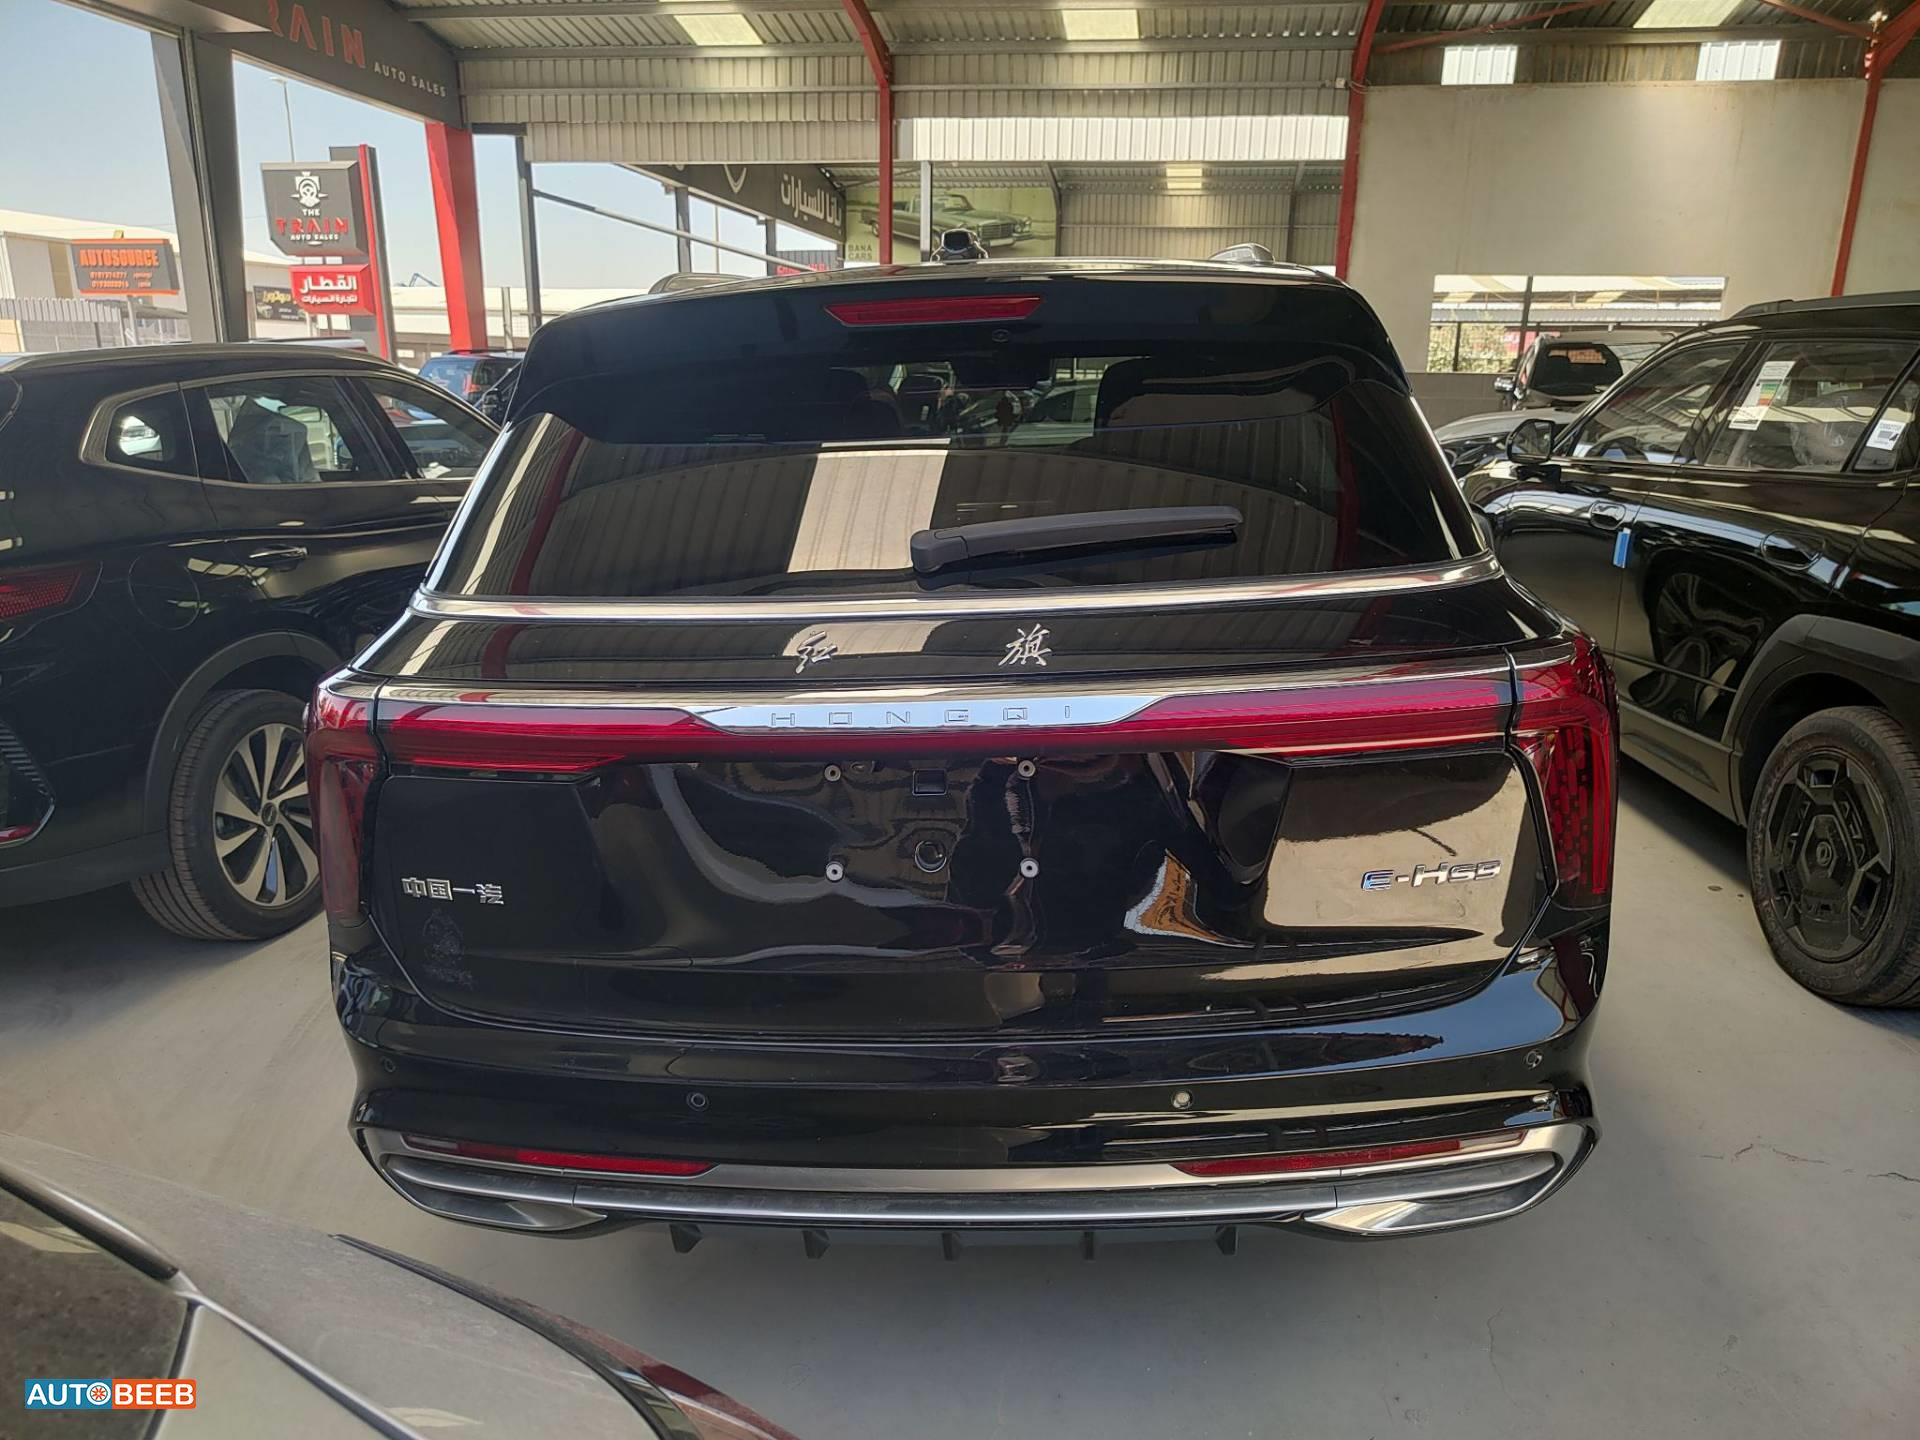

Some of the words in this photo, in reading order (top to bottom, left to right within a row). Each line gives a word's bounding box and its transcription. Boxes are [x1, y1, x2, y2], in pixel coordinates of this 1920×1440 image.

[373, 61, 406, 84] AUTO
[411, 75, 447, 98] SALES
[781, 173, 825, 220] للسيارات
[302, 208, 321, 217] THE
[825, 193, 842, 235] بانا
[275, 217, 349, 234] TRAIN
[290, 233, 312, 241] AUTO
[314, 233, 339, 241] SALES
[79, 248, 160, 267] AUTOSOURCE
[848, 244, 873, 252] BANA
[848, 252, 873, 260] CARS
[300, 274, 357, 294] القطار
[301, 294, 335, 305] السيارات
[771, 705, 1071, 727] HONGQI
[1361, 860, 1502, 892] E-HS9
[401, 877, 505, 905] 中国一汽
